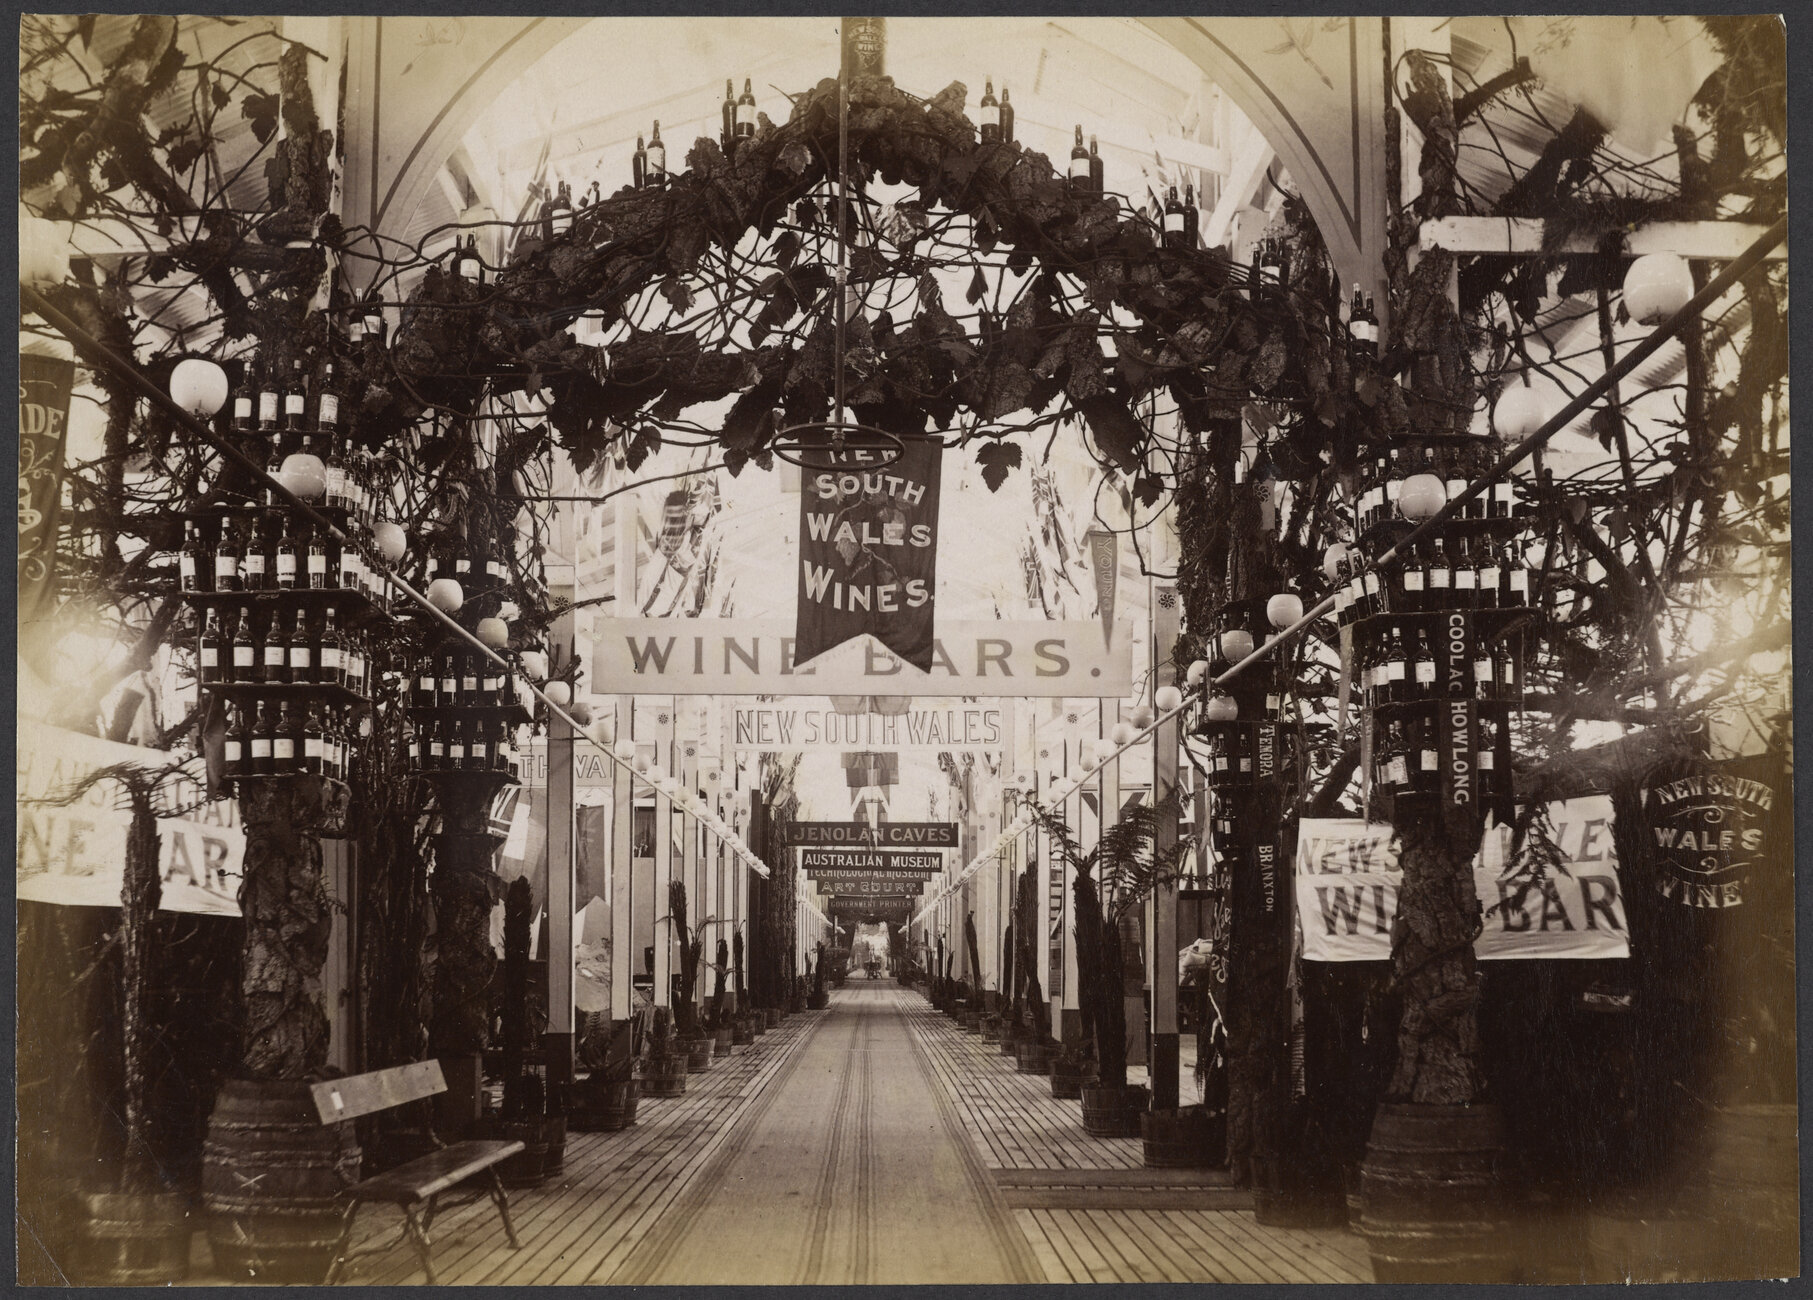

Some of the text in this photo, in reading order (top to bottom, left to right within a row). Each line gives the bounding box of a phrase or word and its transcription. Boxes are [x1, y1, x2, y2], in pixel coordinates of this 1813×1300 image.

[815, 474, 927, 505] SOUTH
[806, 513, 932, 548] WALES
[1449, 613, 1465, 692] COOLAC
[735, 710, 1000, 745] NEW SOUTH WALES
[1451, 701, 1470, 805] HOWLONG
[1654, 773, 1775, 811] NEW SOUTH
[794, 827, 951, 842] JENOLAN CAVES
[1654, 827, 1764, 851] WALES
[804, 853, 940, 869] AUSTRALIAN MUSEUM
[1300, 837, 1380, 876] NEW
[821, 881, 856, 893] ART
[1258, 844, 1275, 912] BRANXTON
